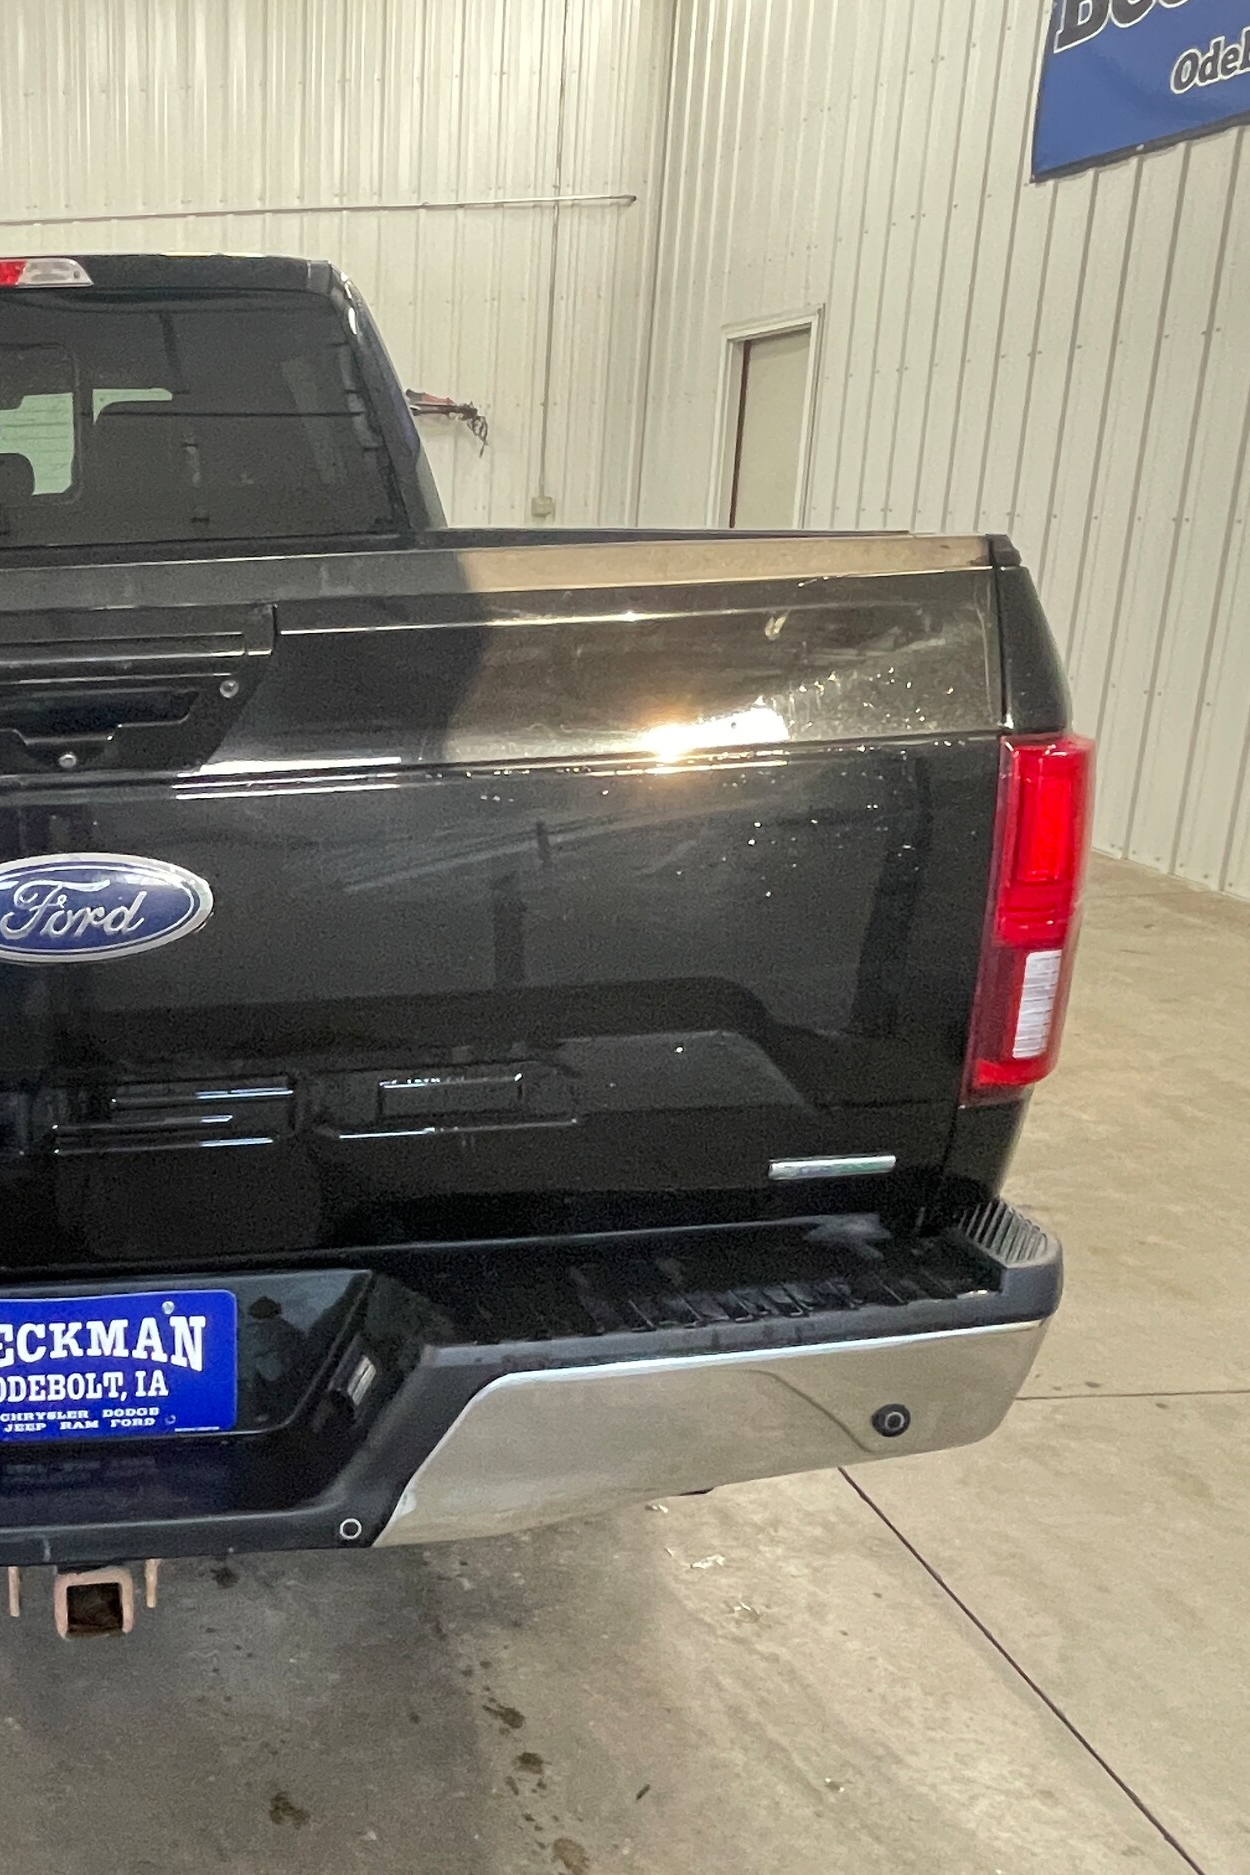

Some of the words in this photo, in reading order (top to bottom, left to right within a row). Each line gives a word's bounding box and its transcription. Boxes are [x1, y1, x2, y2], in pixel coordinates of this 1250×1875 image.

[0, 879, 148, 941] Ford
[135, 1369, 170, 1399] IA
[0, 1410, 90, 1423] CHRYSLER
[102, 1406, 161, 1419] DODGE
[4, 1422, 48, 1433] JEEP
[59, 1420, 100, 1431] RAM
[110, 1417, 157, 1429] FORD
